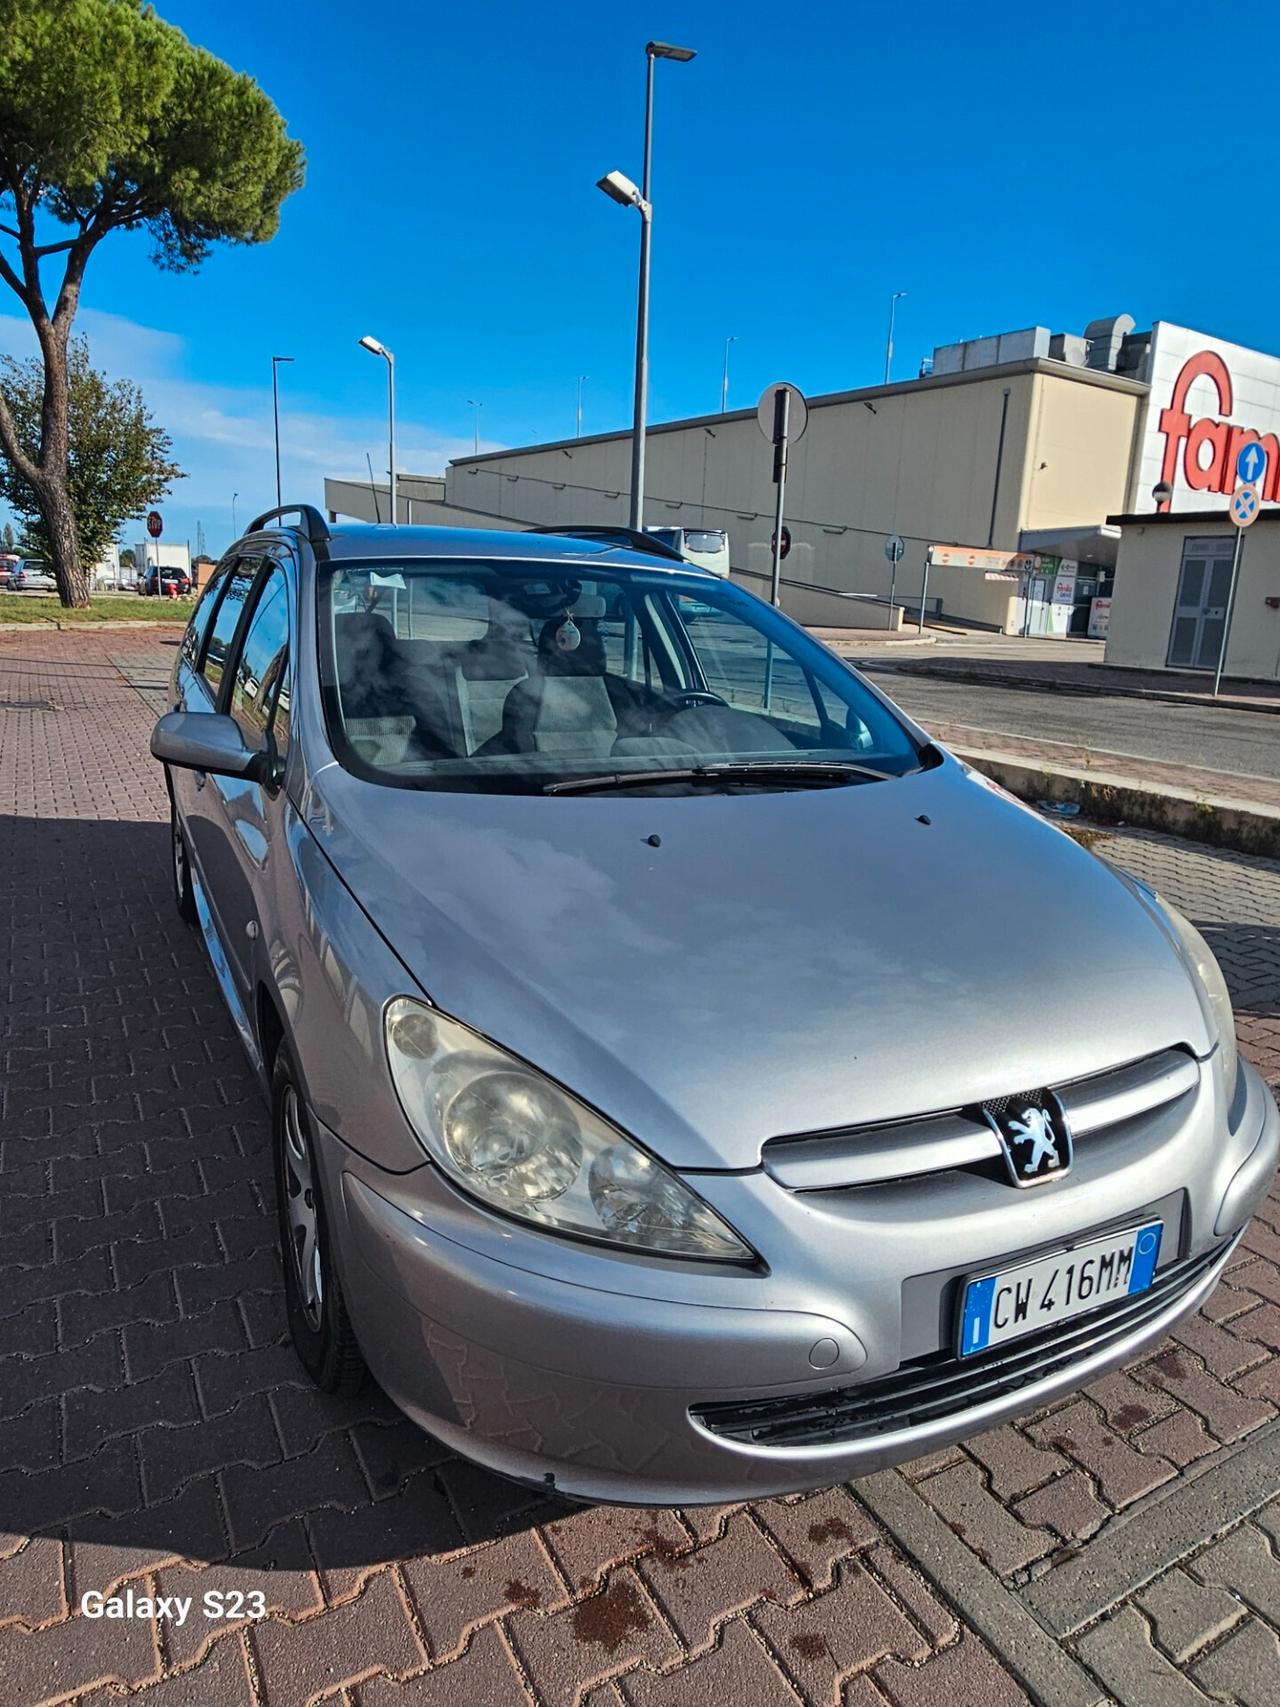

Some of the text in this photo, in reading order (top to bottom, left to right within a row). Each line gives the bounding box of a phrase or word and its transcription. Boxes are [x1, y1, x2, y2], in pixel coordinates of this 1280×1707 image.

[1159, 350, 1280, 512] fam
[994, 1246, 1134, 1329] CW 416MM
